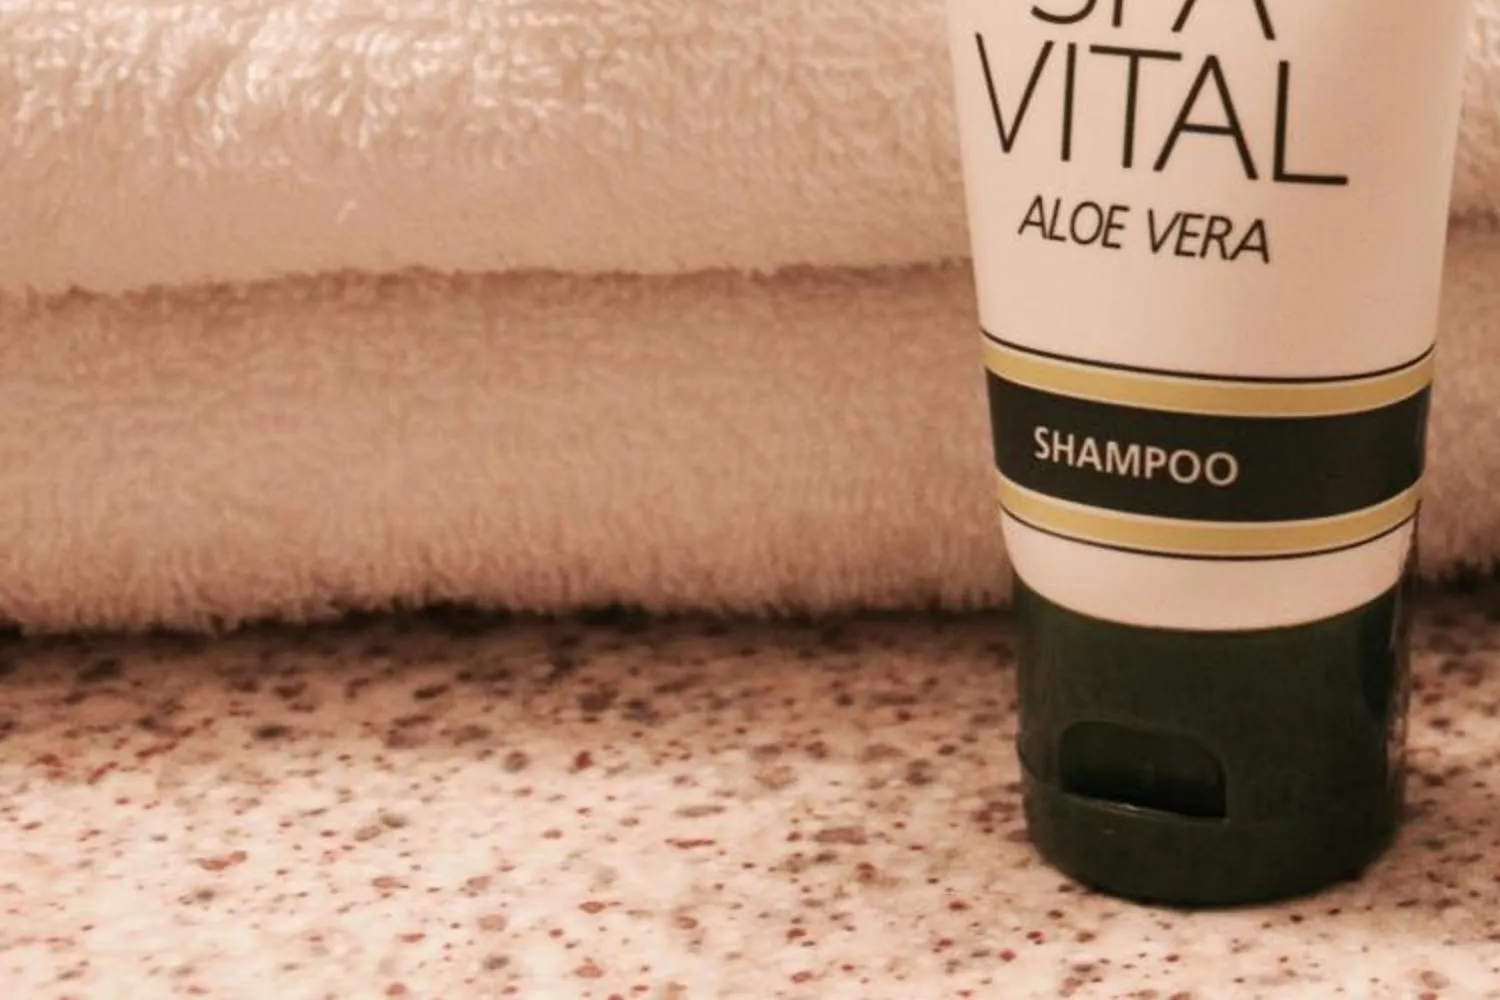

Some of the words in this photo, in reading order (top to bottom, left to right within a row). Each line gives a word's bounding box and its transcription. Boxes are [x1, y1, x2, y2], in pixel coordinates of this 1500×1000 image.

[975, 32, 1350, 188] VITAL
[1017, 194, 1131, 250] ALOE
[1147, 208, 1271, 265] VERA
[1032, 425, 1240, 488] SHAMPOO
